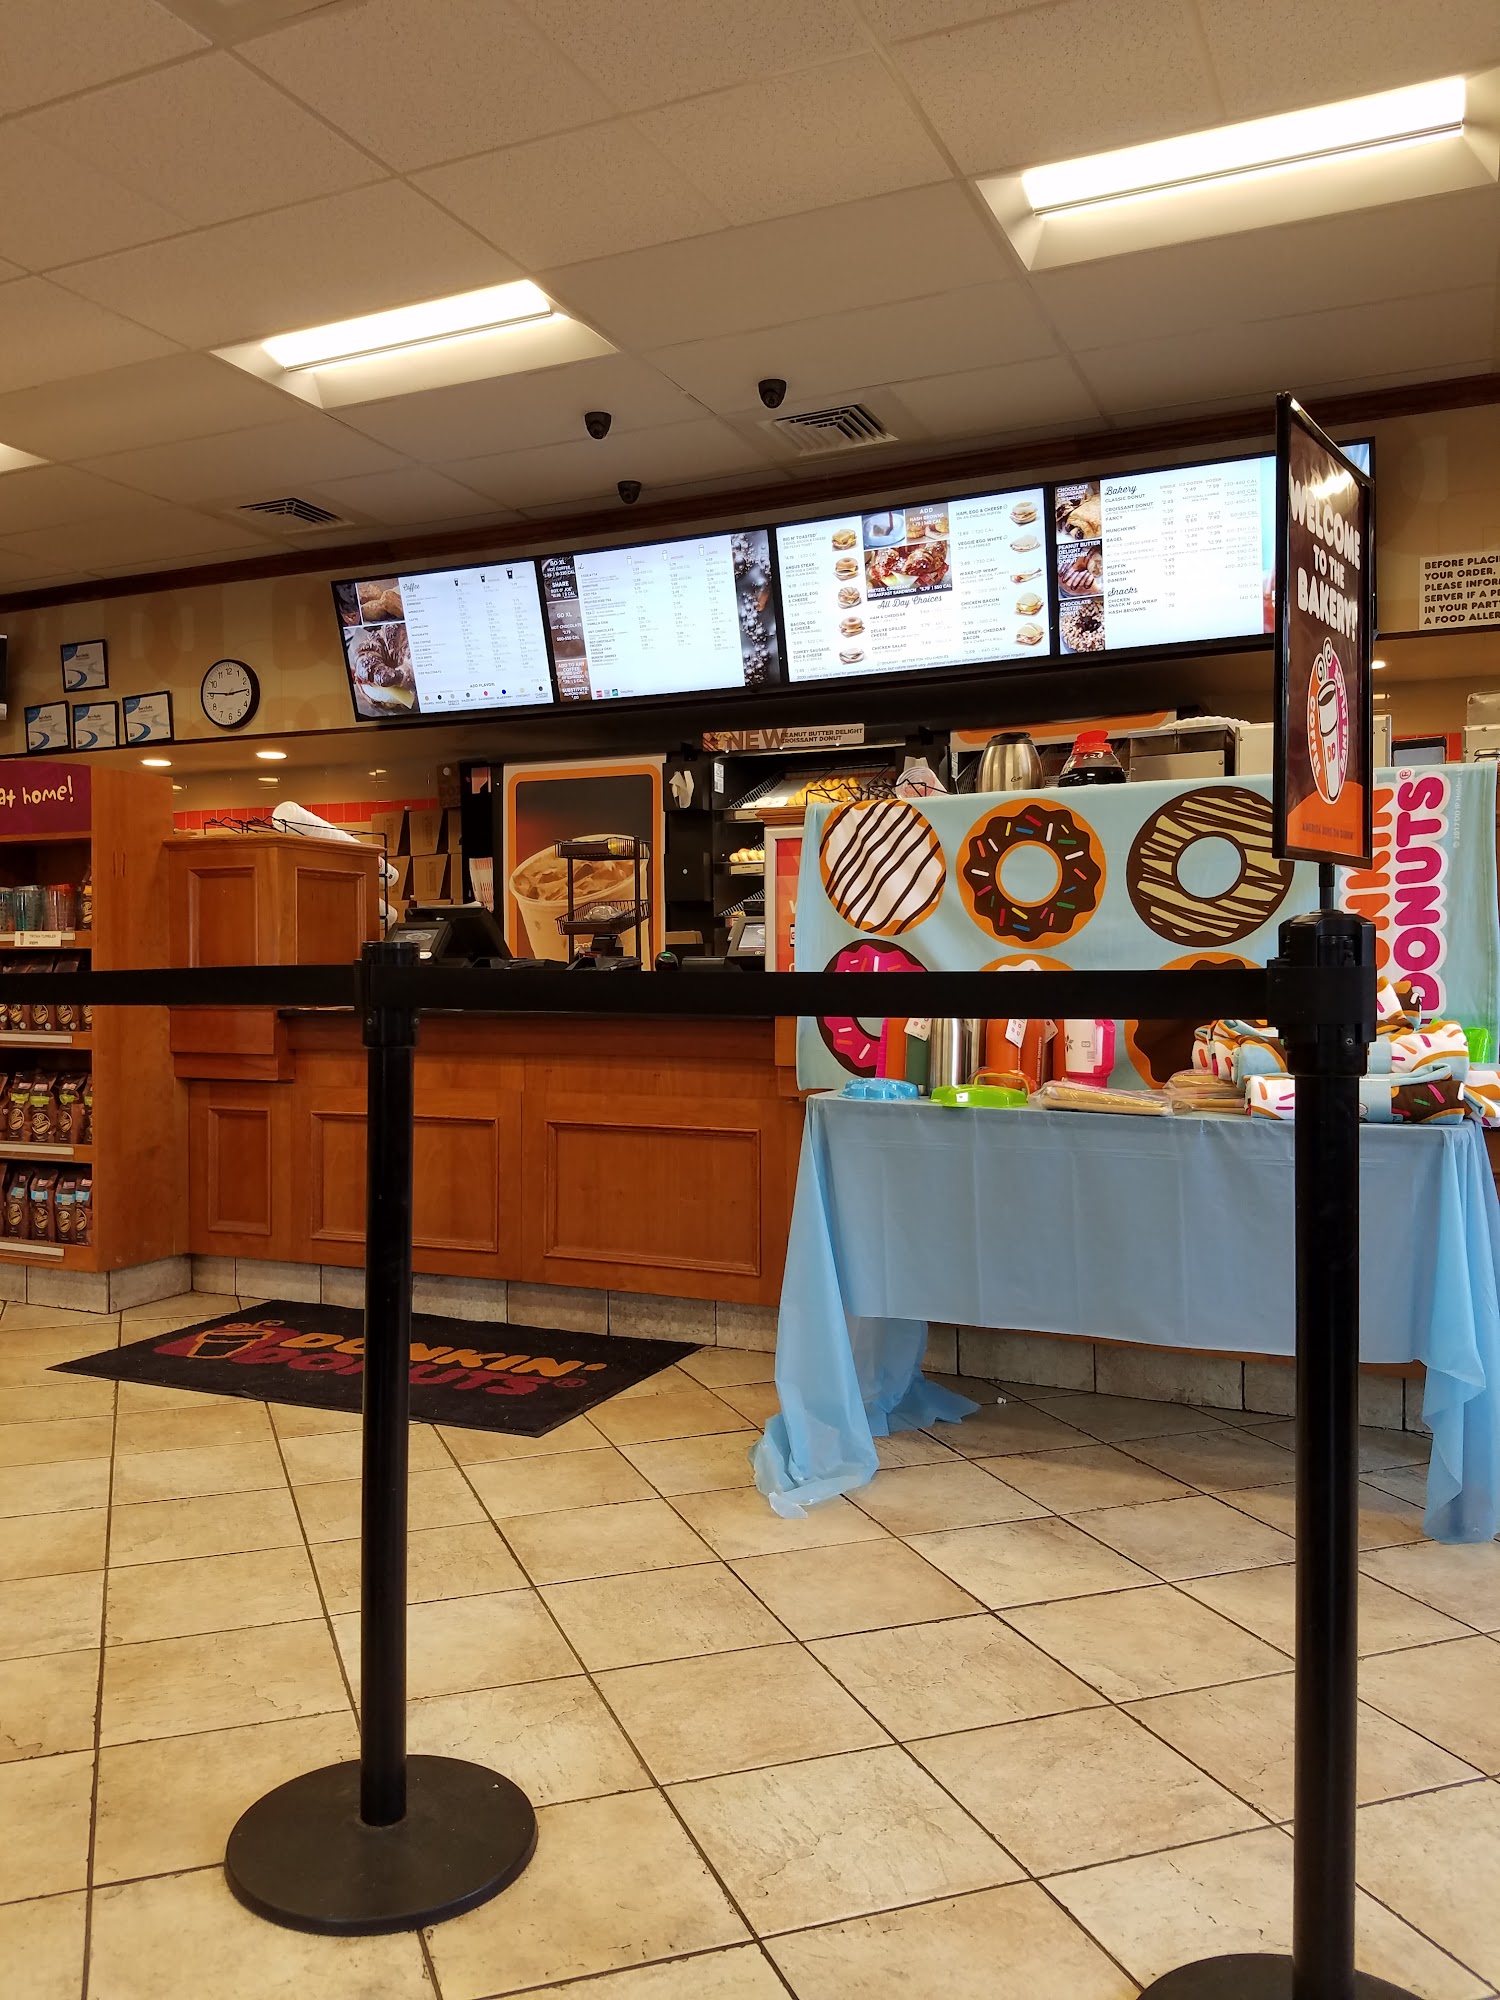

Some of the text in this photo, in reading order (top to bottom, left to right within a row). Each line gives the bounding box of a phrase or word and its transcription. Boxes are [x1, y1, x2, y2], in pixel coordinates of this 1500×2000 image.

[1057, 484, 1088, 492] CHOCOLATE
[1104, 485, 1137, 496] Bakery
[1289, 475, 1361, 570] WELCOME
[1313, 544, 1345, 589] TO THE
[1424, 556, 1500, 569] BEFORE PLACI
[1424, 568, 1496, 580] YOUR ORDER,
[402, 583, 420, 592] Coffee
[1425, 578, 1500, 591] PLEASE INFOR
[1107, 586, 1138, 597] Snacks
[1425, 593, 1463, 602] SERVER
[877, 596, 942, 609] All Day Choices
[1298, 567, 1358, 642] BAKERY!
[1439, 603, 1467, 612] YOUR
[1435, 615, 1465, 623] FOOD
[243, 677, 247, 685] 2
[244, 700, 247, 708] 4
[237, 709, 241, 717] 5
[727, 728, 789, 750] NEW
[781, 731, 807, 739] PEANUT
[1309, 695, 1321, 778] COFFEE
[0, 775, 74, 808] at home!
[1455, 777, 1463, 801] Holder
[1453, 822, 1461, 840] 2017
